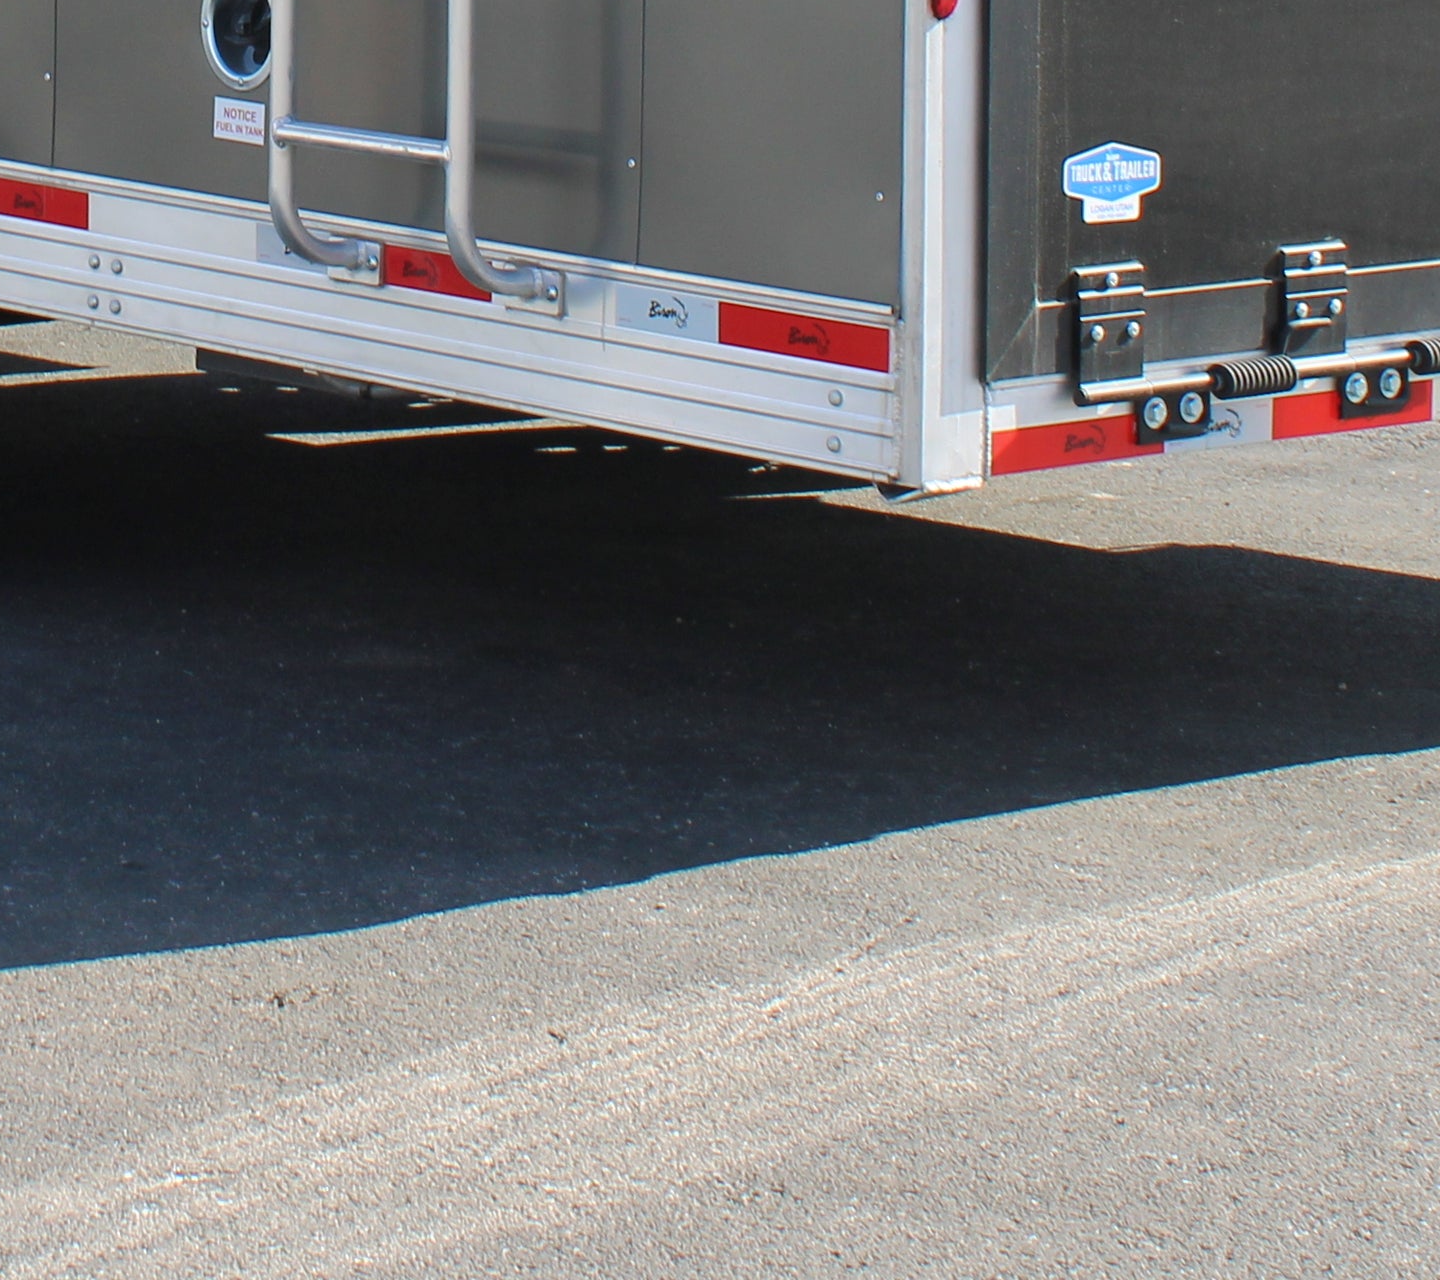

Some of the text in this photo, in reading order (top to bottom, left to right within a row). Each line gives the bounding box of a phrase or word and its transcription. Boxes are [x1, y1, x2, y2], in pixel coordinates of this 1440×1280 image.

[223, 107, 257, 123] NOTICE
[216, 121, 264, 137] FUEL IN TANK
[1071, 159, 1156, 183] TRUCK & TRAILER
